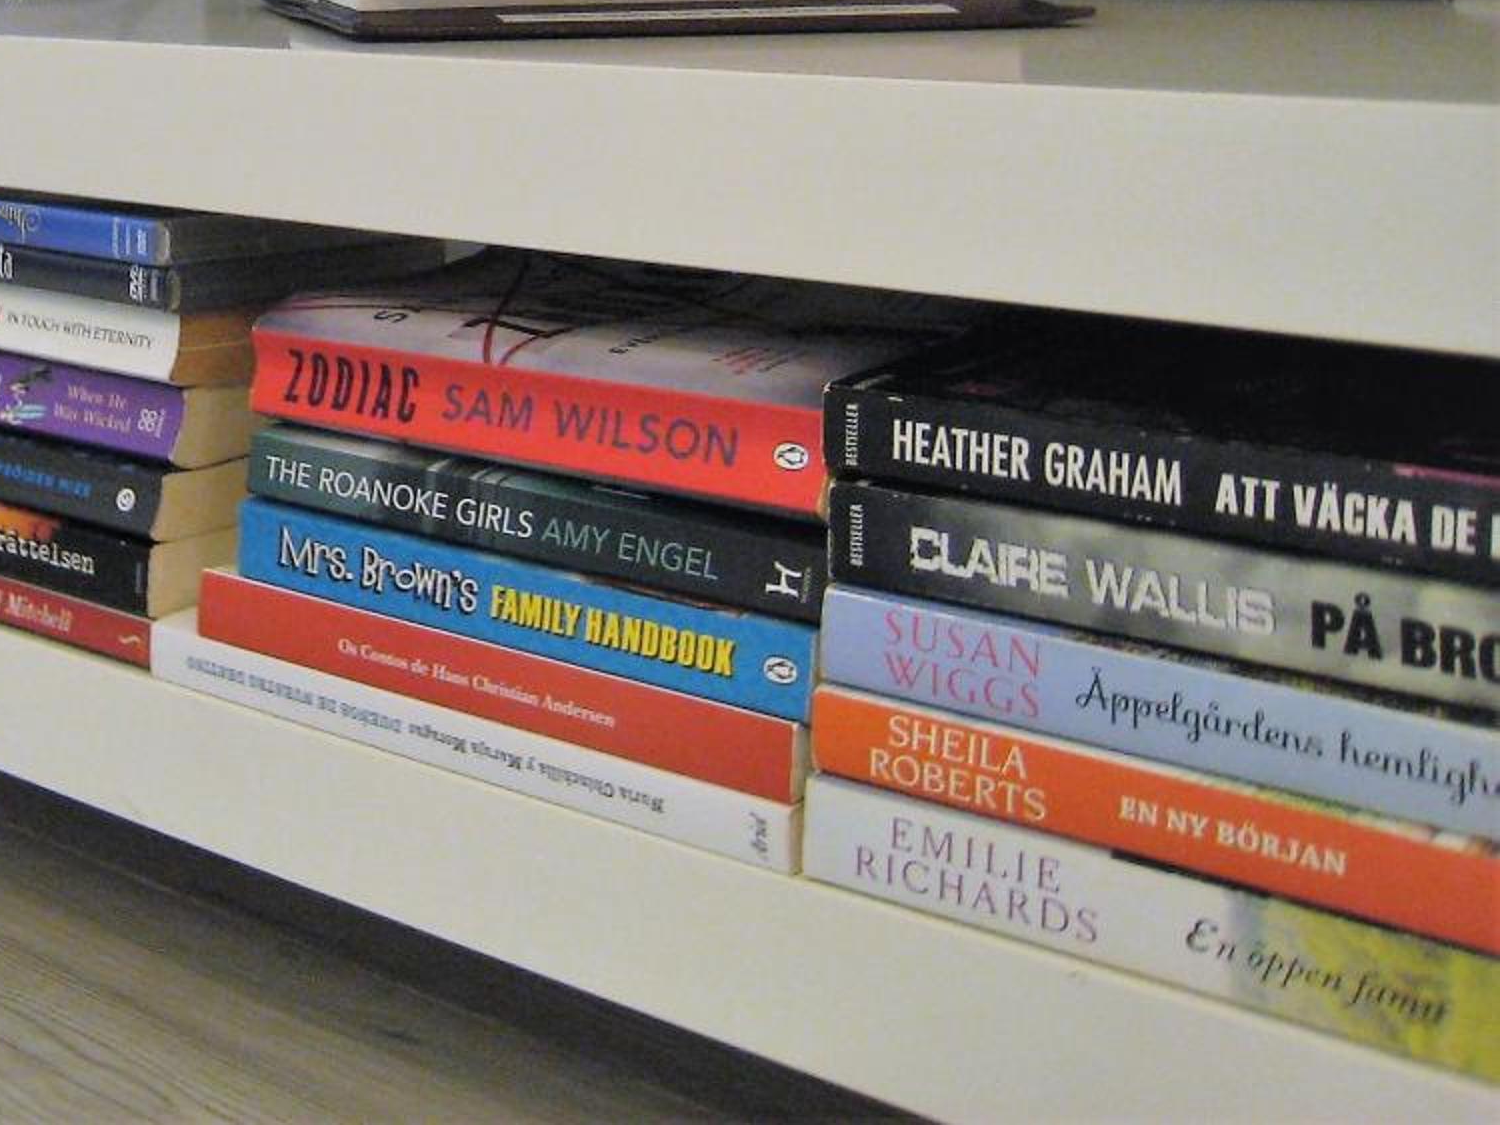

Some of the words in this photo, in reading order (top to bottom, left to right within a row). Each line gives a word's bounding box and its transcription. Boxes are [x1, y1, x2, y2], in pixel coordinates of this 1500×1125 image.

[20, 314, 60, 332] TOUCH
[63, 322, 91, 339] WITH
[93, 326, 153, 349] ETERNITY
[284, 348, 421, 423] ZODIAC
[441, 384, 535, 434] SAM
[554, 400, 740, 467] WILSON
[844, 403, 860, 467] BESTSELLER
[265, 456, 312, 490] THE
[319, 467, 449, 521] ROANOKE
[456, 497, 534, 539] GIRLS
[542, 516, 611, 553] AMY
[617, 533, 718, 581] ENGEL
[892, 418, 1031, 483] HEATHER
[1044, 441, 1183, 506] GRAHAM
[1215, 472, 1281, 522] ATT
[1293, 479, 1418, 546] VÄCKA
[1430, 503, 1478, 555] DE
[849, 503, 865, 567] BESTSELLER
[5, 591, 73, 632] Mitchell
[278, 526, 355, 582] Mrs.
[360, 545, 479, 614] Brown's
[489, 584, 582, 638] FAMILY
[586, 609, 736, 678] HANDBOOK
[909, 525, 1070, 600] CLAIRE
[1085, 558, 1277, 636] WALLIS
[1310, 590, 1384, 662] PÅ
[884, 606, 1042, 680] SUSAN
[317, 695, 338, 715] DE
[411, 659, 429, 677] de
[432, 661, 470, 687] Hans
[472, 674, 540, 708] Christian
[542, 693, 616, 728] Andersen
[884, 650, 1040, 719] WIGGS
[1074, 665, 1325, 759] Äppelgårdens
[888, 713, 1028, 780] SHEILA
[868, 746, 1047, 823] ROBERTS
[890, 816, 1061, 895] EMILIE
[1118, 794, 1160, 824] EN
[1165, 808, 1209, 840] NY
[1216, 819, 1350, 878] BÖRJAN
[855, 845, 1098, 944] RICHARDS
[1184, 918, 1237, 963] En
[1248, 939, 1342, 992] öppen
